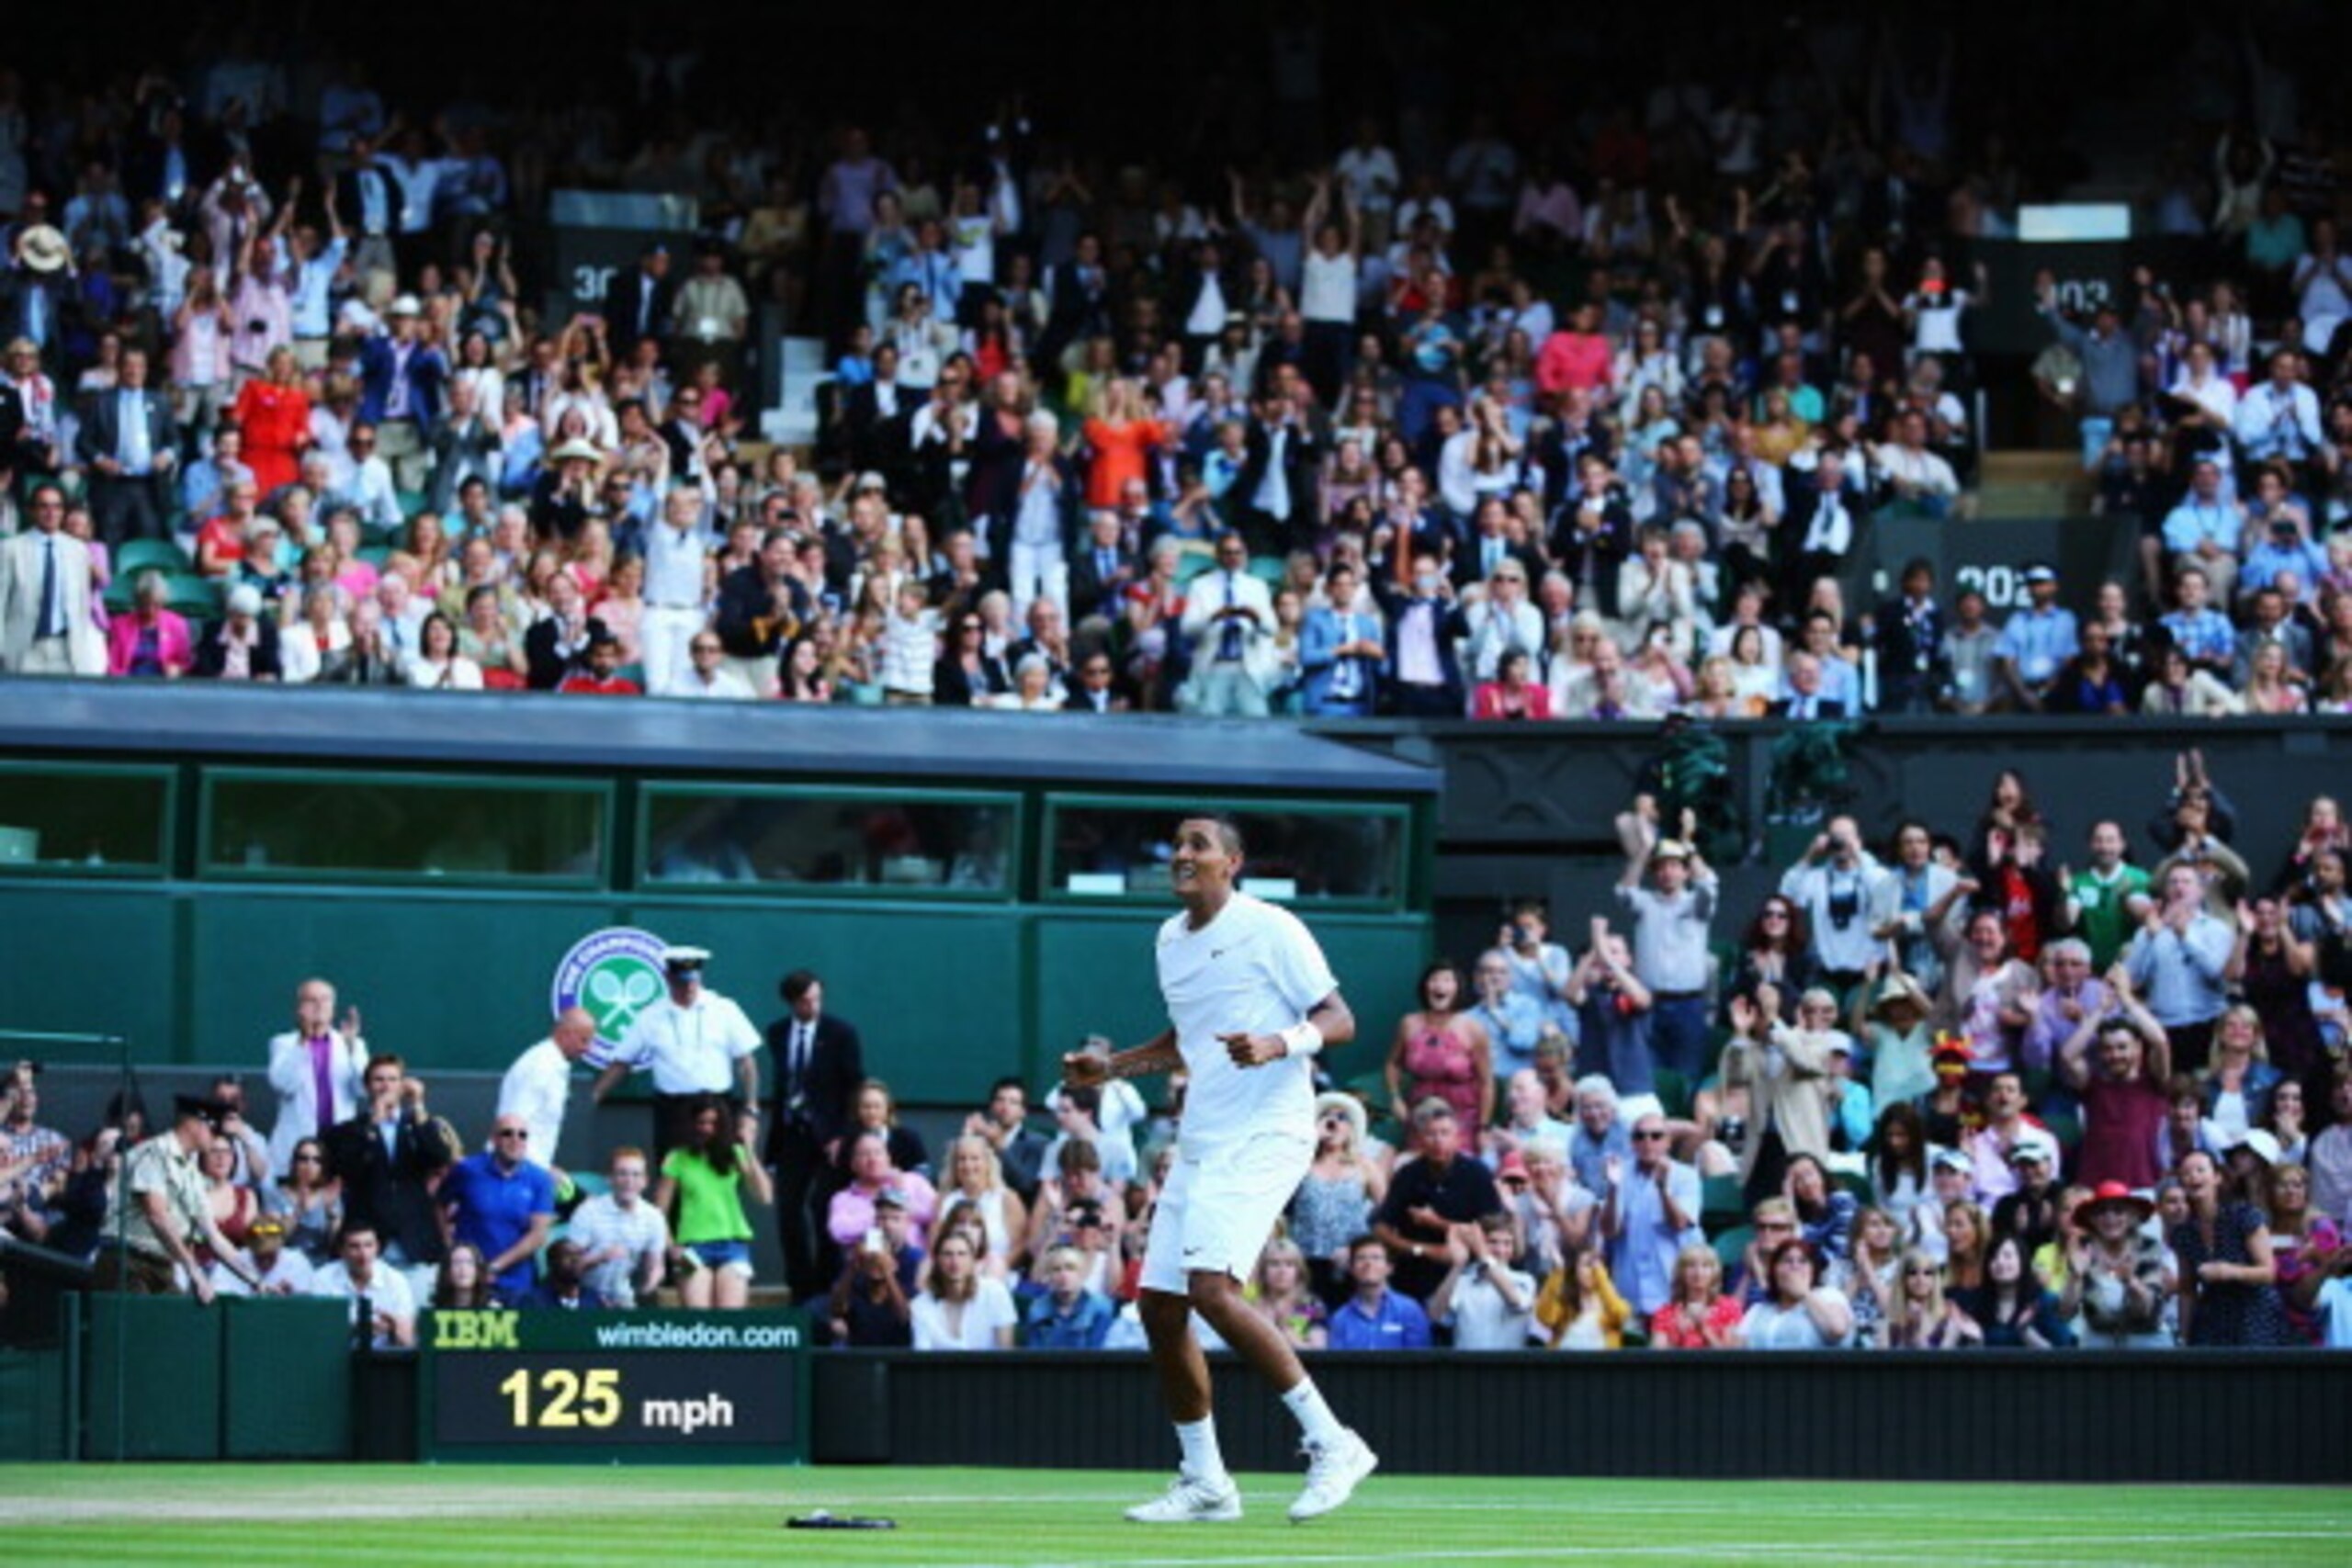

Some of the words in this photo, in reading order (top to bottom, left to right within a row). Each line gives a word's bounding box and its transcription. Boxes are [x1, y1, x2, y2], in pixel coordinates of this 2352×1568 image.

[573, 265, 618, 300] 30
[434, 1310, 520, 1348] IBM
[596, 1320, 799, 1348] wimbledon.com
[499, 1368, 622, 1428] 125
[642, 1393, 734, 1434] mph
